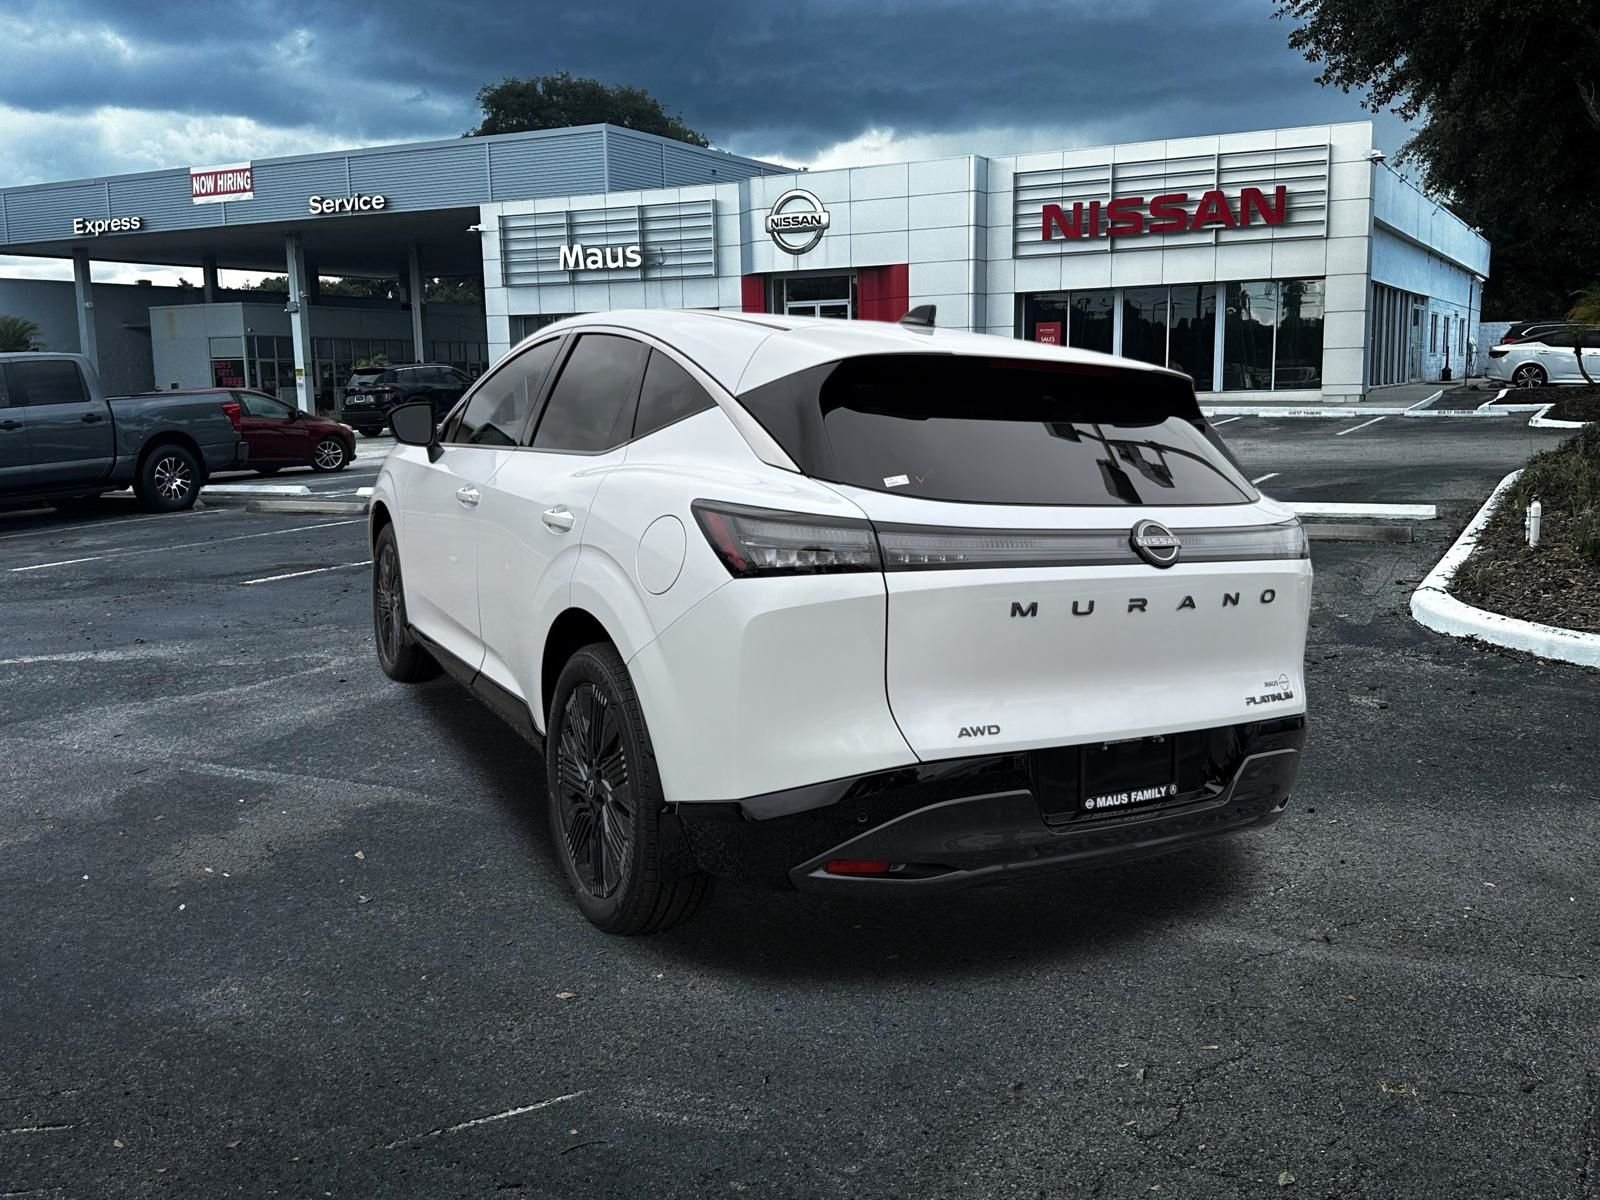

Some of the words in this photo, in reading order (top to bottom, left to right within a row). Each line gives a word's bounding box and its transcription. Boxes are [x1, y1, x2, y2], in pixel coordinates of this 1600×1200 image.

[193, 174, 215, 195] NOW
[217, 171, 251, 192] HIRING
[308, 193, 385, 215] Service
[1042, 185, 1287, 241] NISSAN
[73, 216, 141, 237] Express
[770, 215, 822, 228] NISSAN
[560, 243, 642, 271] Maus
[1136, 536, 1180, 546] NISSAN
[1010, 588, 1276, 617] MURANO
[1245, 690, 1293, 706] PLATINUM
[958, 724, 1001, 738] AWD
[1096, 794, 1128, 808] MAUS
[1131, 786, 1166, 802] FAMILY
